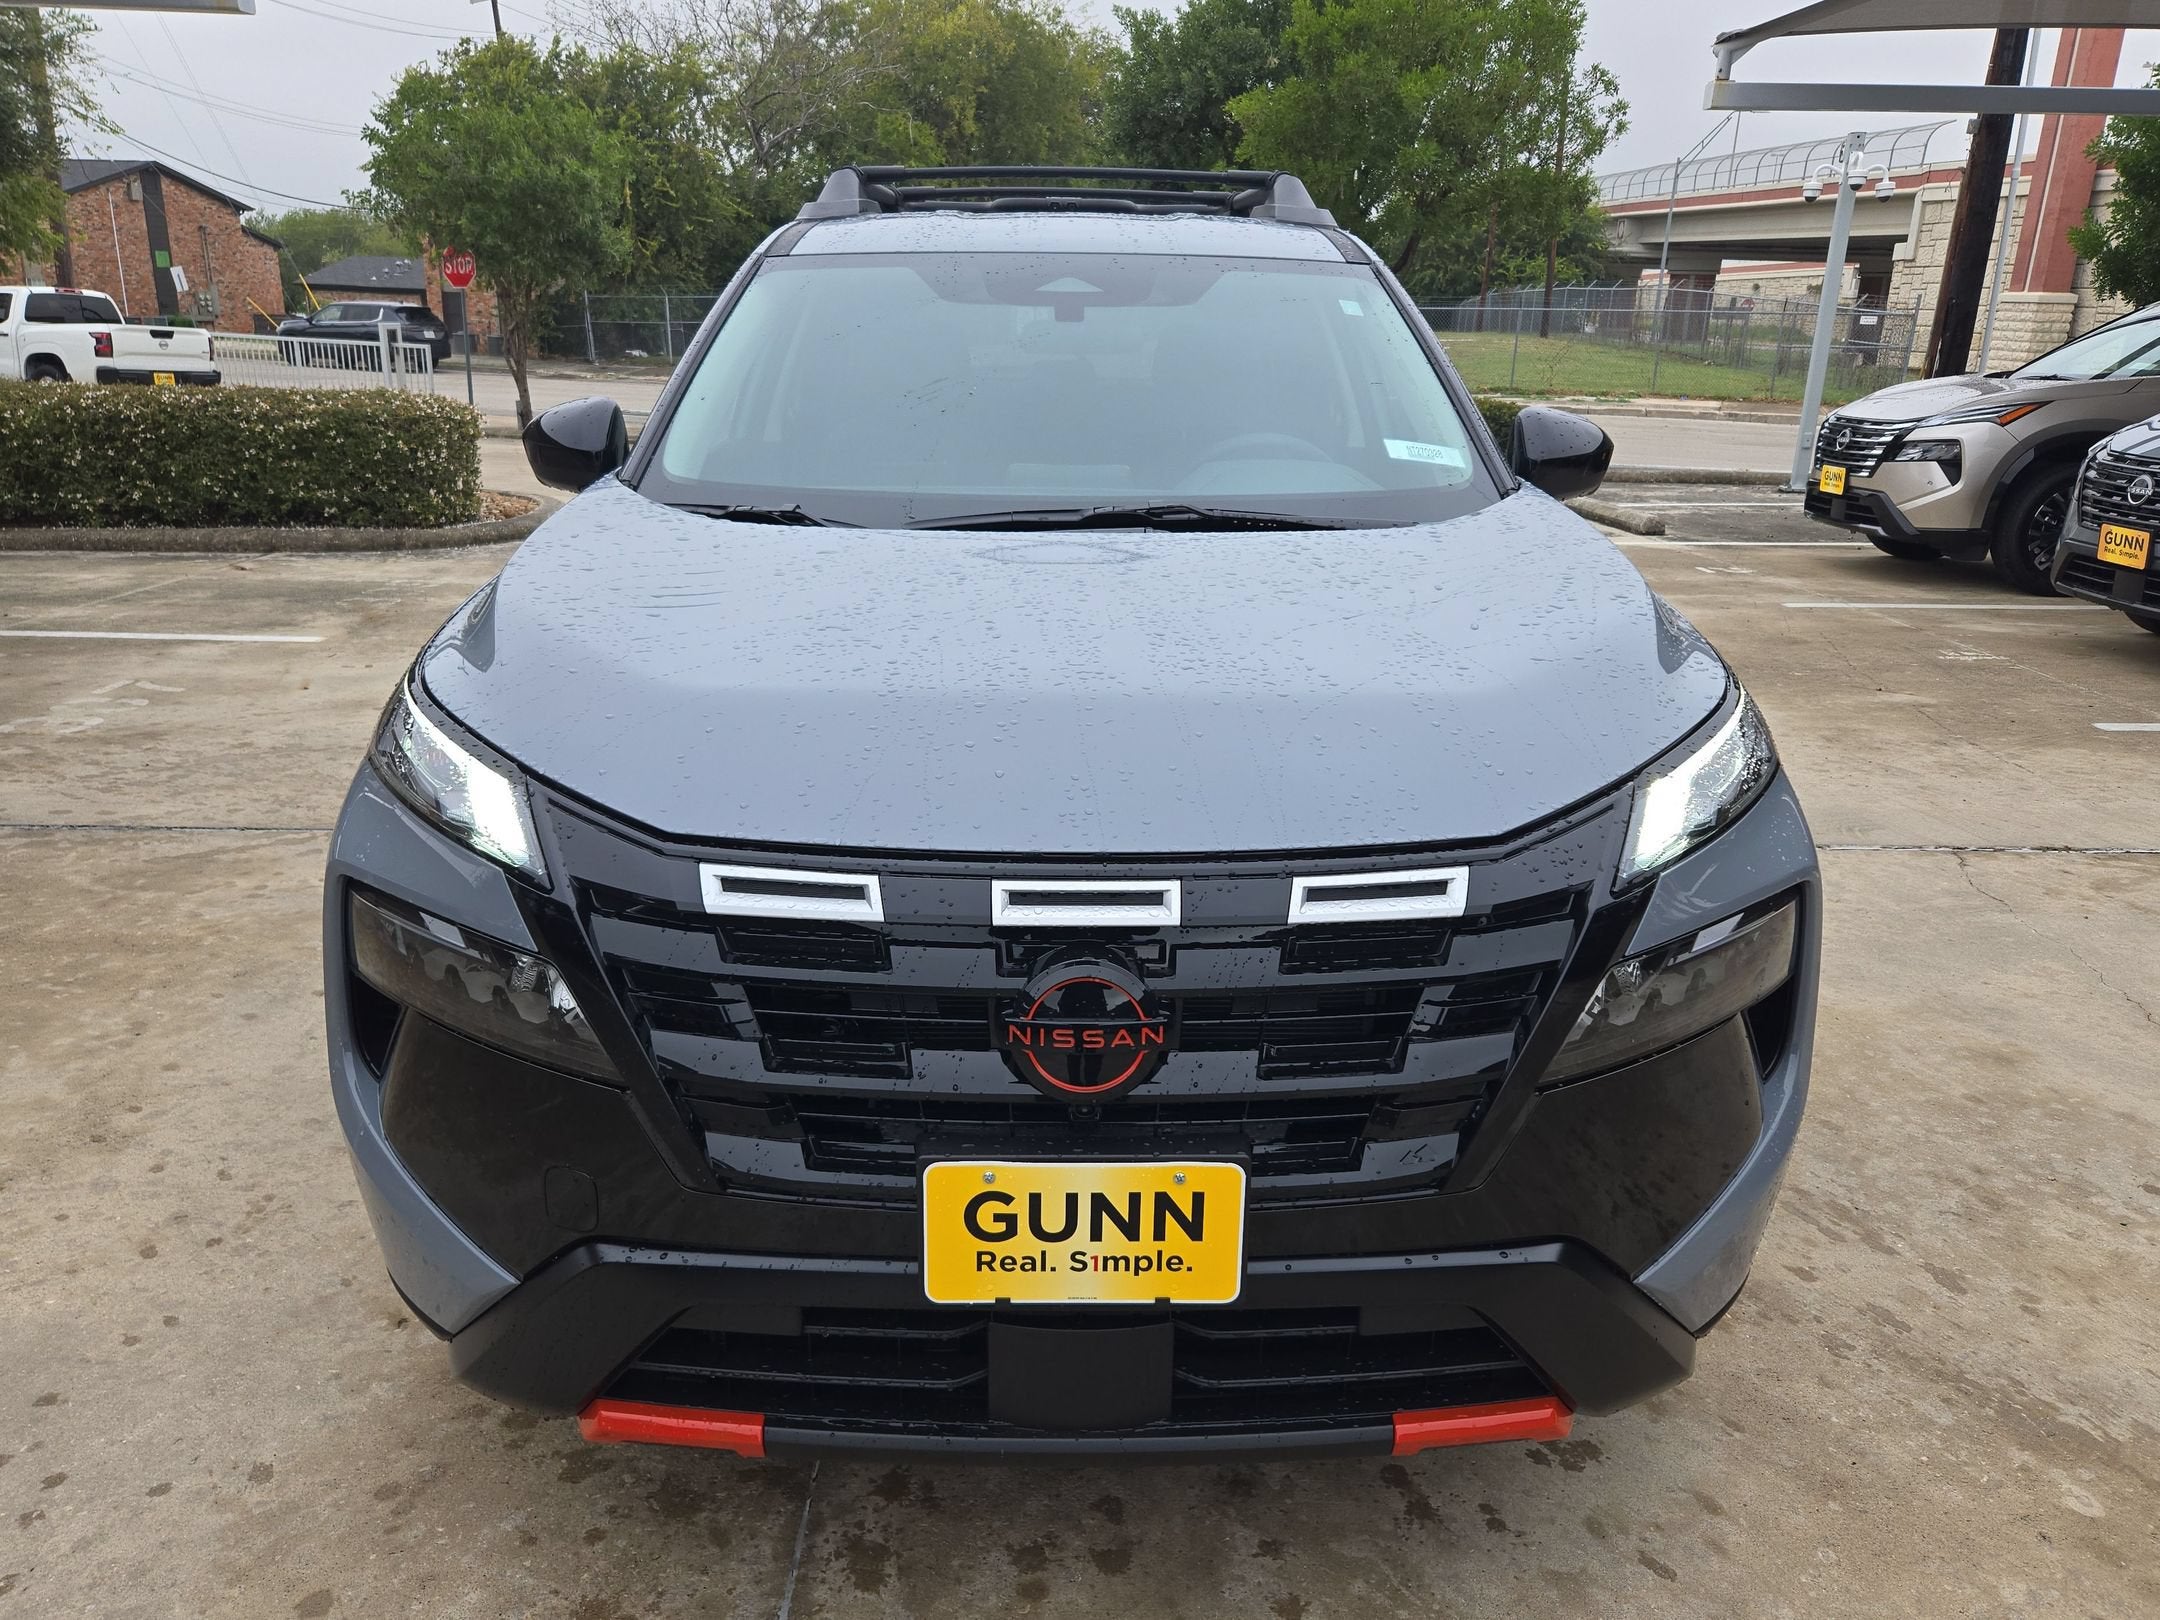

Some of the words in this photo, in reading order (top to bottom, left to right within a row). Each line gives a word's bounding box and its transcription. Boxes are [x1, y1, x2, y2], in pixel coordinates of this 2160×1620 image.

[444, 256, 473, 275] STOP
[1824, 470, 1842, 482] GUNN
[2104, 530, 2145, 552] GUNN
[1008, 1023, 1164, 1049] NISSAN
[963, 1190, 1205, 1243] GUNN
[976, 1250, 1057, 1273] Real.
